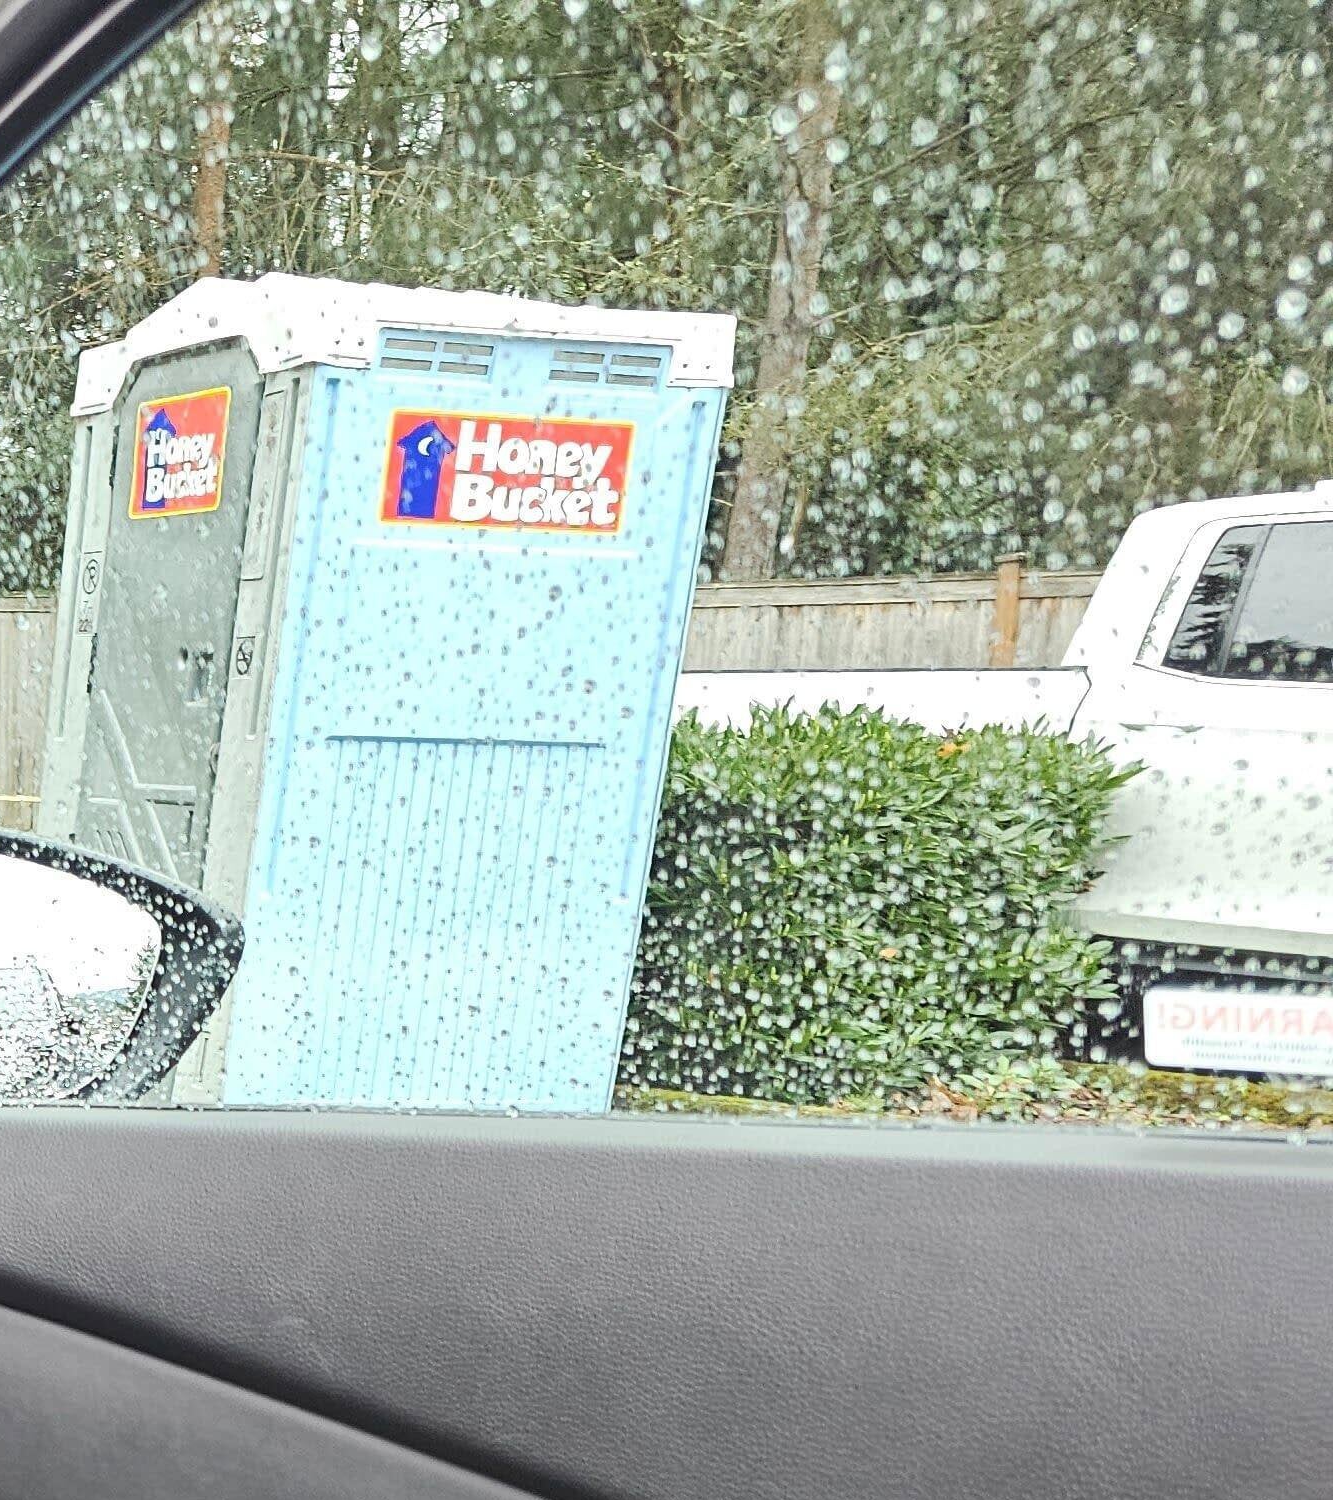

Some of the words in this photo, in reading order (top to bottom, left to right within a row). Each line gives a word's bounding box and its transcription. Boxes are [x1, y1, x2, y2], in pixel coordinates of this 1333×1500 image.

[146, 429, 215, 468] Honey
[455, 419, 613, 490] Honey
[145, 461, 217, 502] Bucket
[450, 473, 619, 526] Bucket
